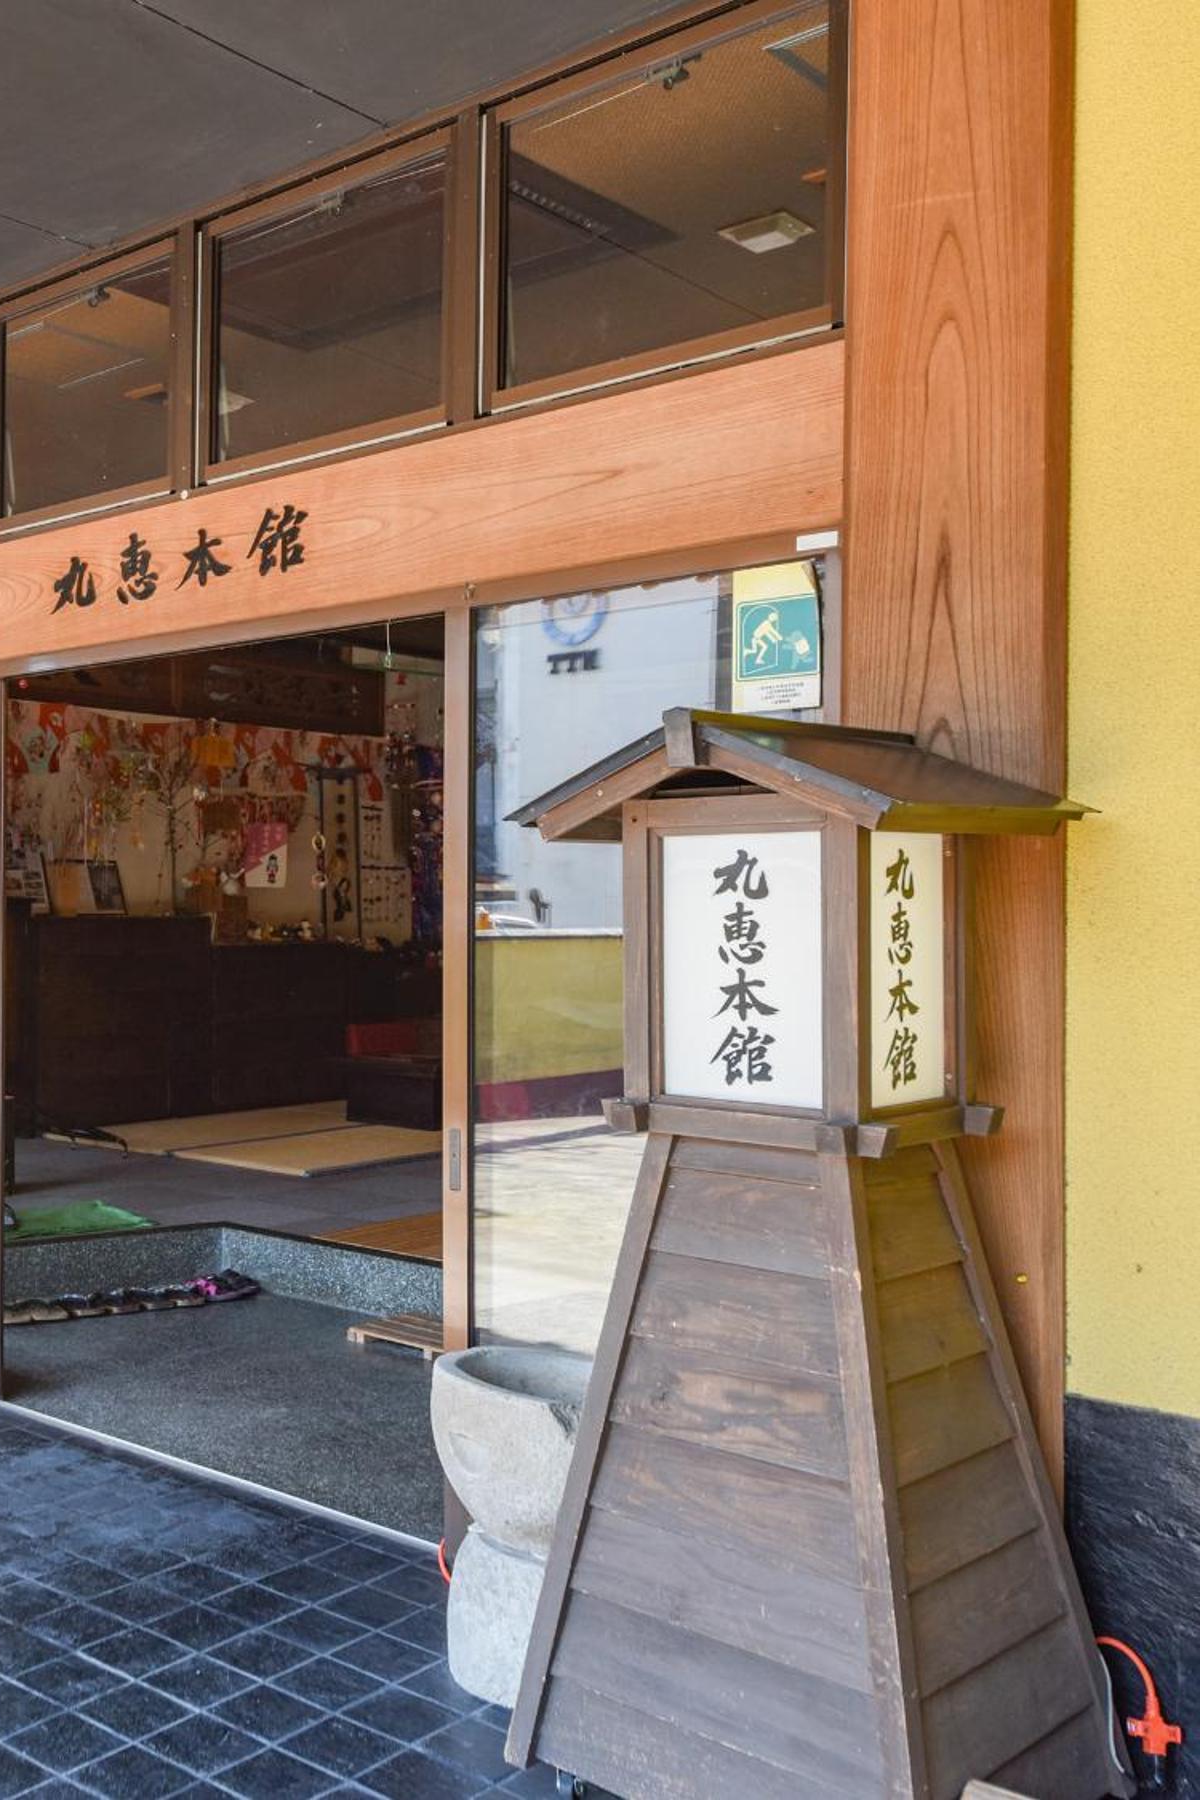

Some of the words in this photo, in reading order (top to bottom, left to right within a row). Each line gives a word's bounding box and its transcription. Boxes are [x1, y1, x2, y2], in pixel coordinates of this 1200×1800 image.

[50, 505, 308, 615] 丸恵本館
[710, 849, 780, 1086] 丸恵本館
[883, 848, 921, 1091] 丸恵本館
